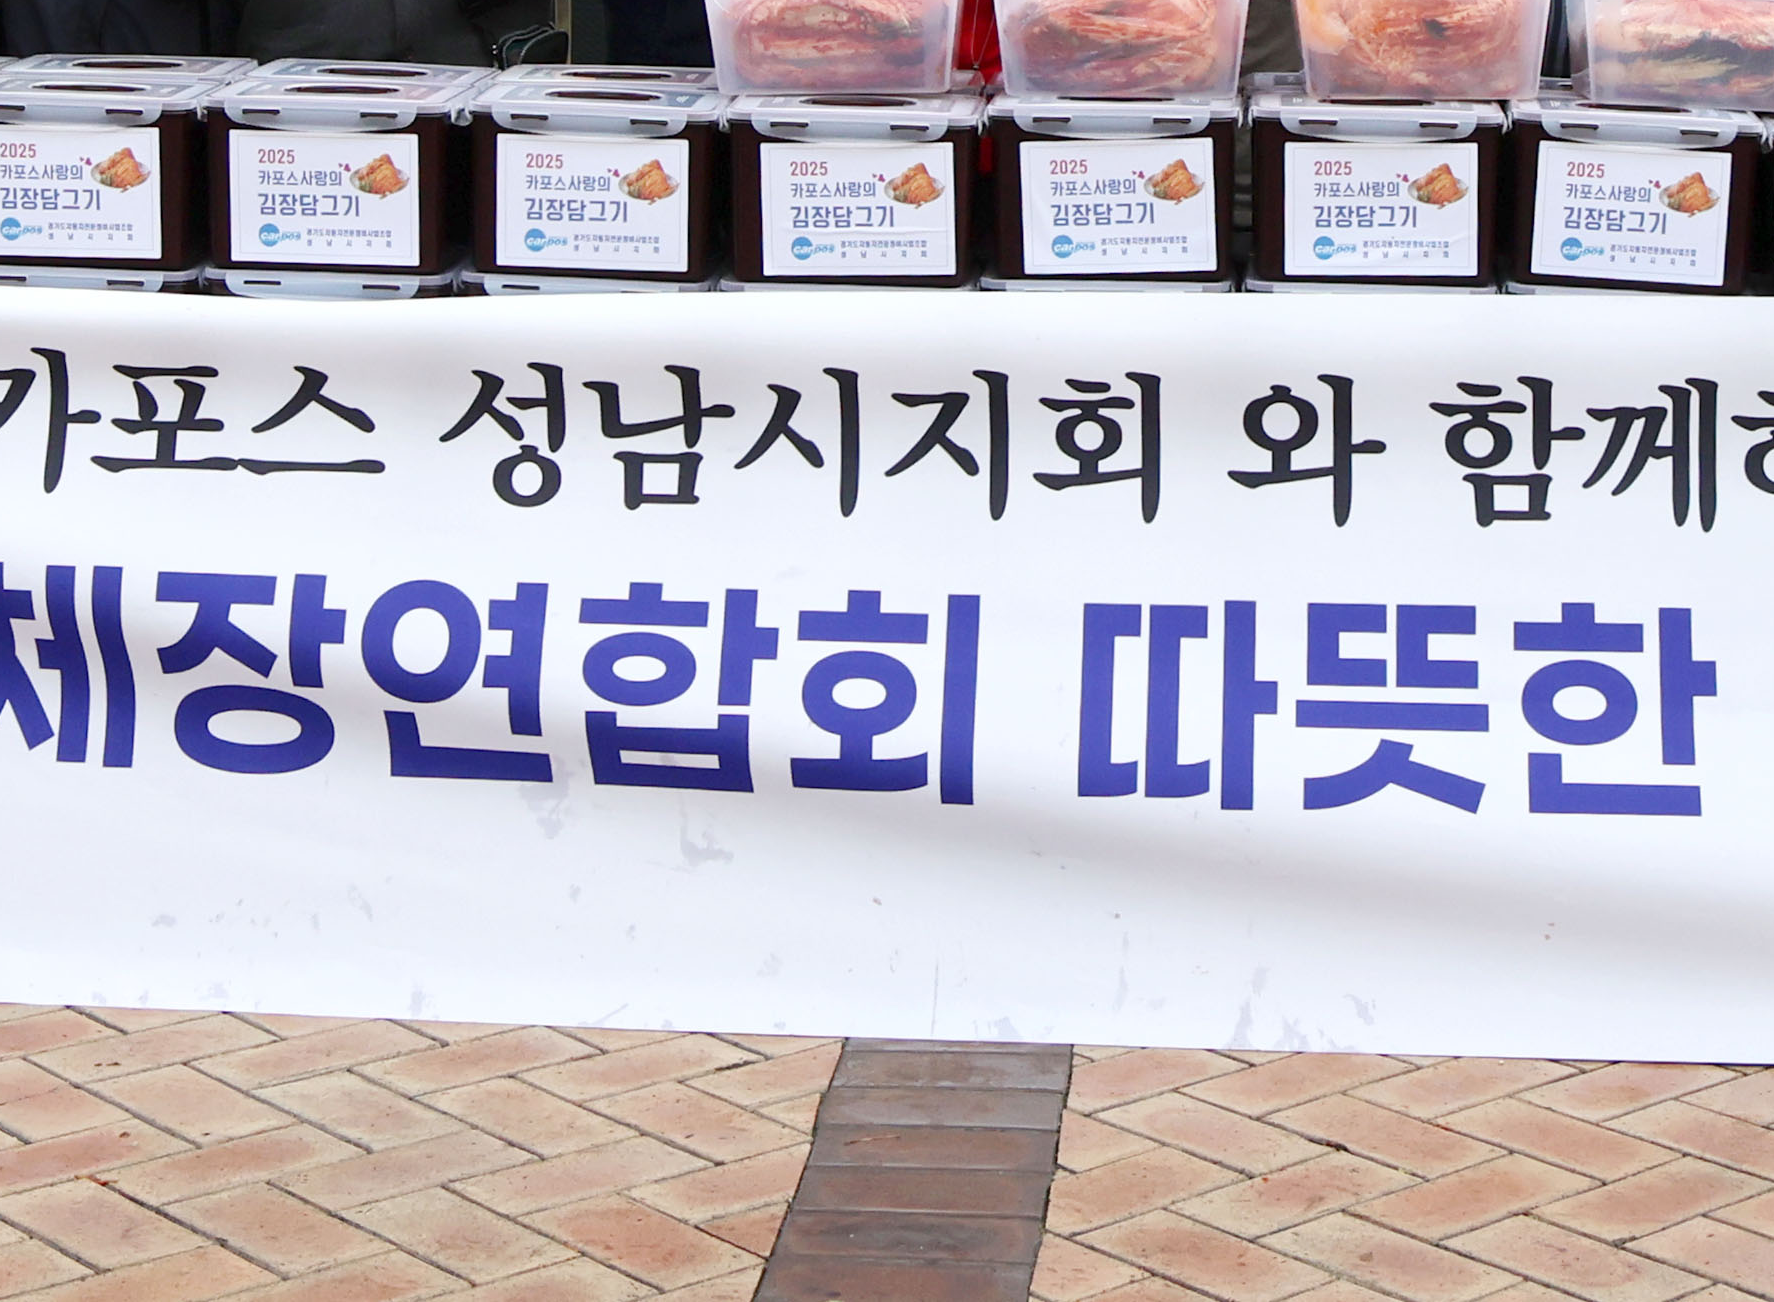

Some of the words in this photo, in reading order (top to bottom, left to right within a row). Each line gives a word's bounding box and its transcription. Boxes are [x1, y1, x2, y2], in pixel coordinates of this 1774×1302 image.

[0, 143, 36, 159] 2025
[258, 148, 294, 164] 2025
[525, 153, 563, 169] 2025
[790, 161, 828, 177] 2025
[1049, 159, 1087, 175] 2025
[1314, 160, 1352, 176] 2025
[1567, 161, 1605, 179] 2025
[0, 164, 83, 180] 카포스사랑의
[259, 170, 341, 187] 카포스사랑의
[526, 175, 610, 192] 카포스사랑의
[791, 181, 876, 198] 카포스사랑의
[1051, 178, 1136, 197] 카포스사랑의
[1314, 181, 1399, 198] 카포스사랑의
[0, 187, 101, 211] 김장담그기
[1566, 183, 1651, 203] 카포스사랑의
[258, 192, 359, 218] 김장담그기
[524, 197, 628, 223] 김장담그기
[790, 205, 894, 229] 김장담그기
[1050, 202, 1154, 227] 김장담그기
[1313, 205, 1417, 229] 김장담그기
[1563, 206, 1667, 235] 김장담그기
[438, 361, 1162, 525] 성남시지회
[1227, 374, 1387, 528] 와
[1077, 599, 1718, 818] 따뜻한
